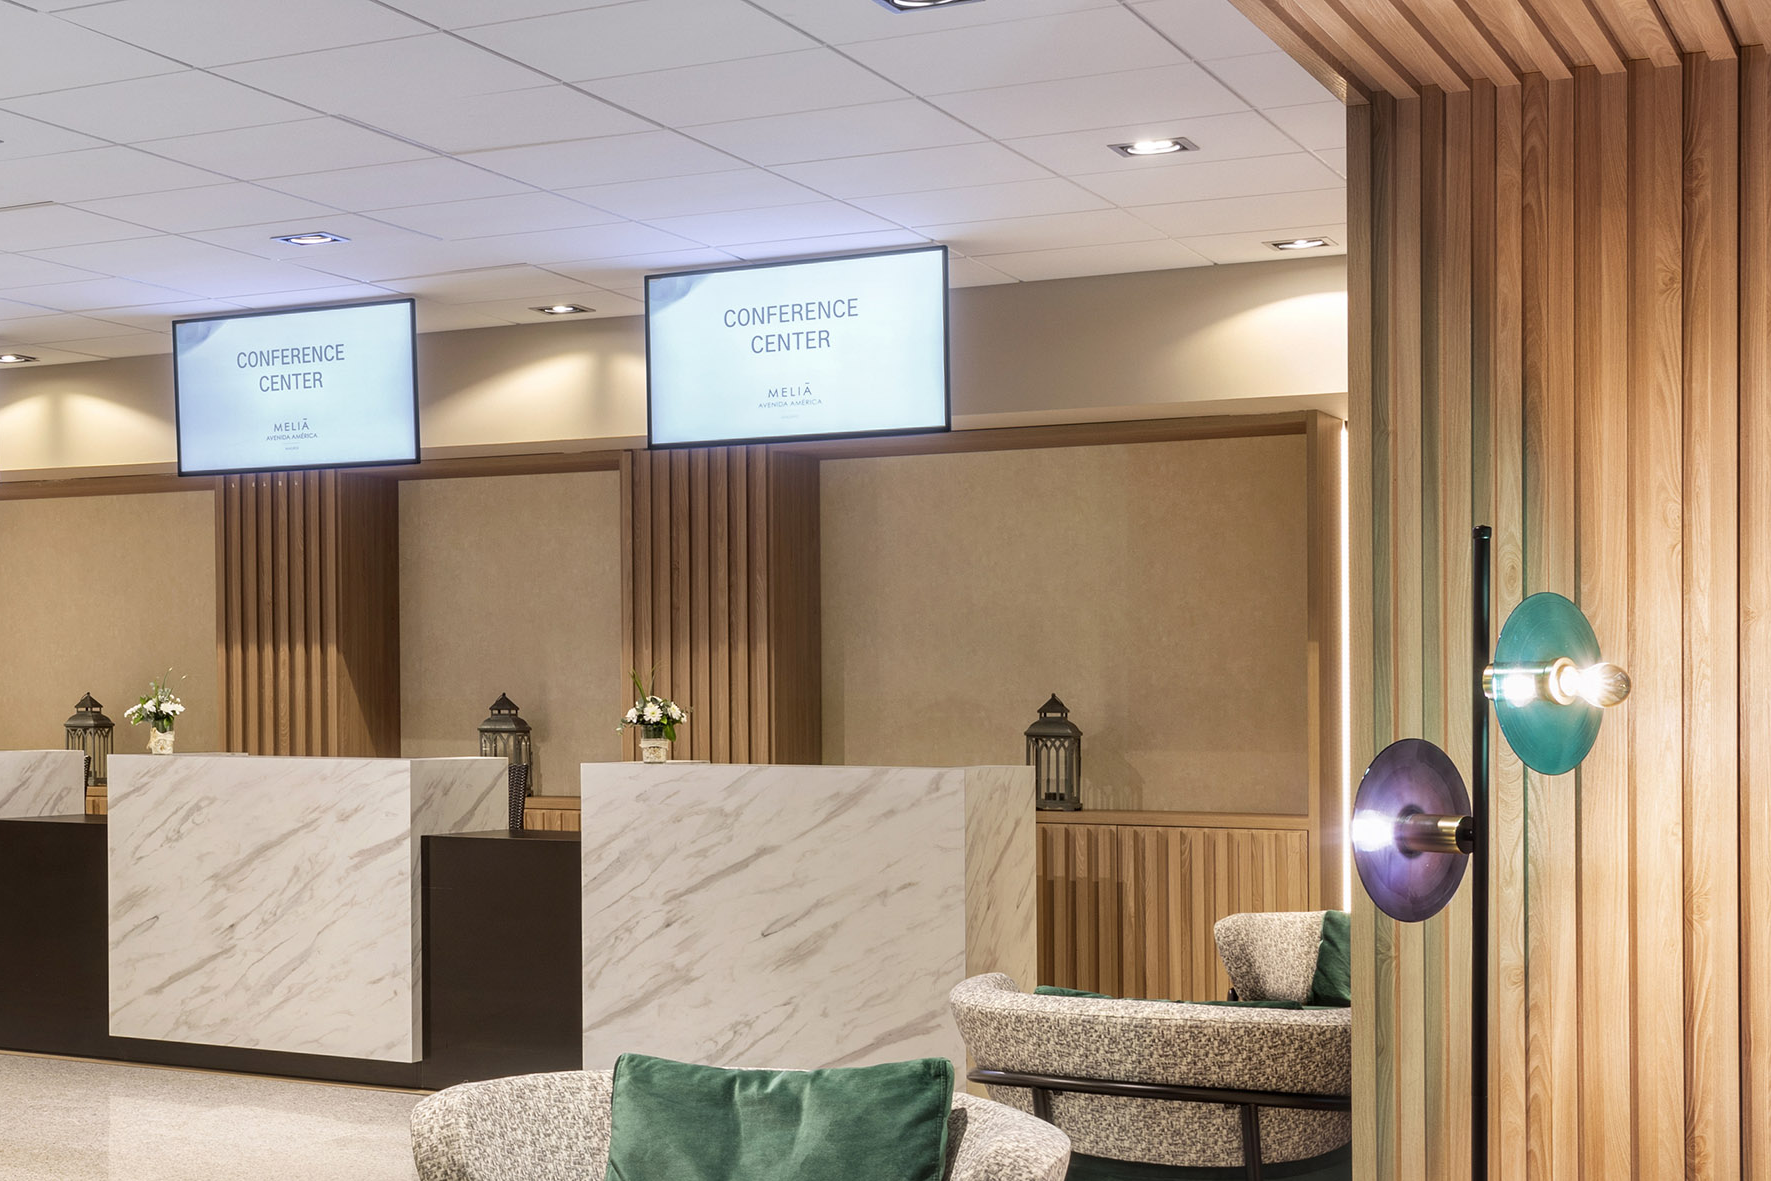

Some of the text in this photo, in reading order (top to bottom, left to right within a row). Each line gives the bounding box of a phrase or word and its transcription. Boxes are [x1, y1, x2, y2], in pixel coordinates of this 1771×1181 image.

[723, 298, 858, 328] CONFERENCE
[751, 330, 831, 354] CENTER
[236, 343, 345, 368] CONFERENCE
[259, 371, 323, 392] CENTER
